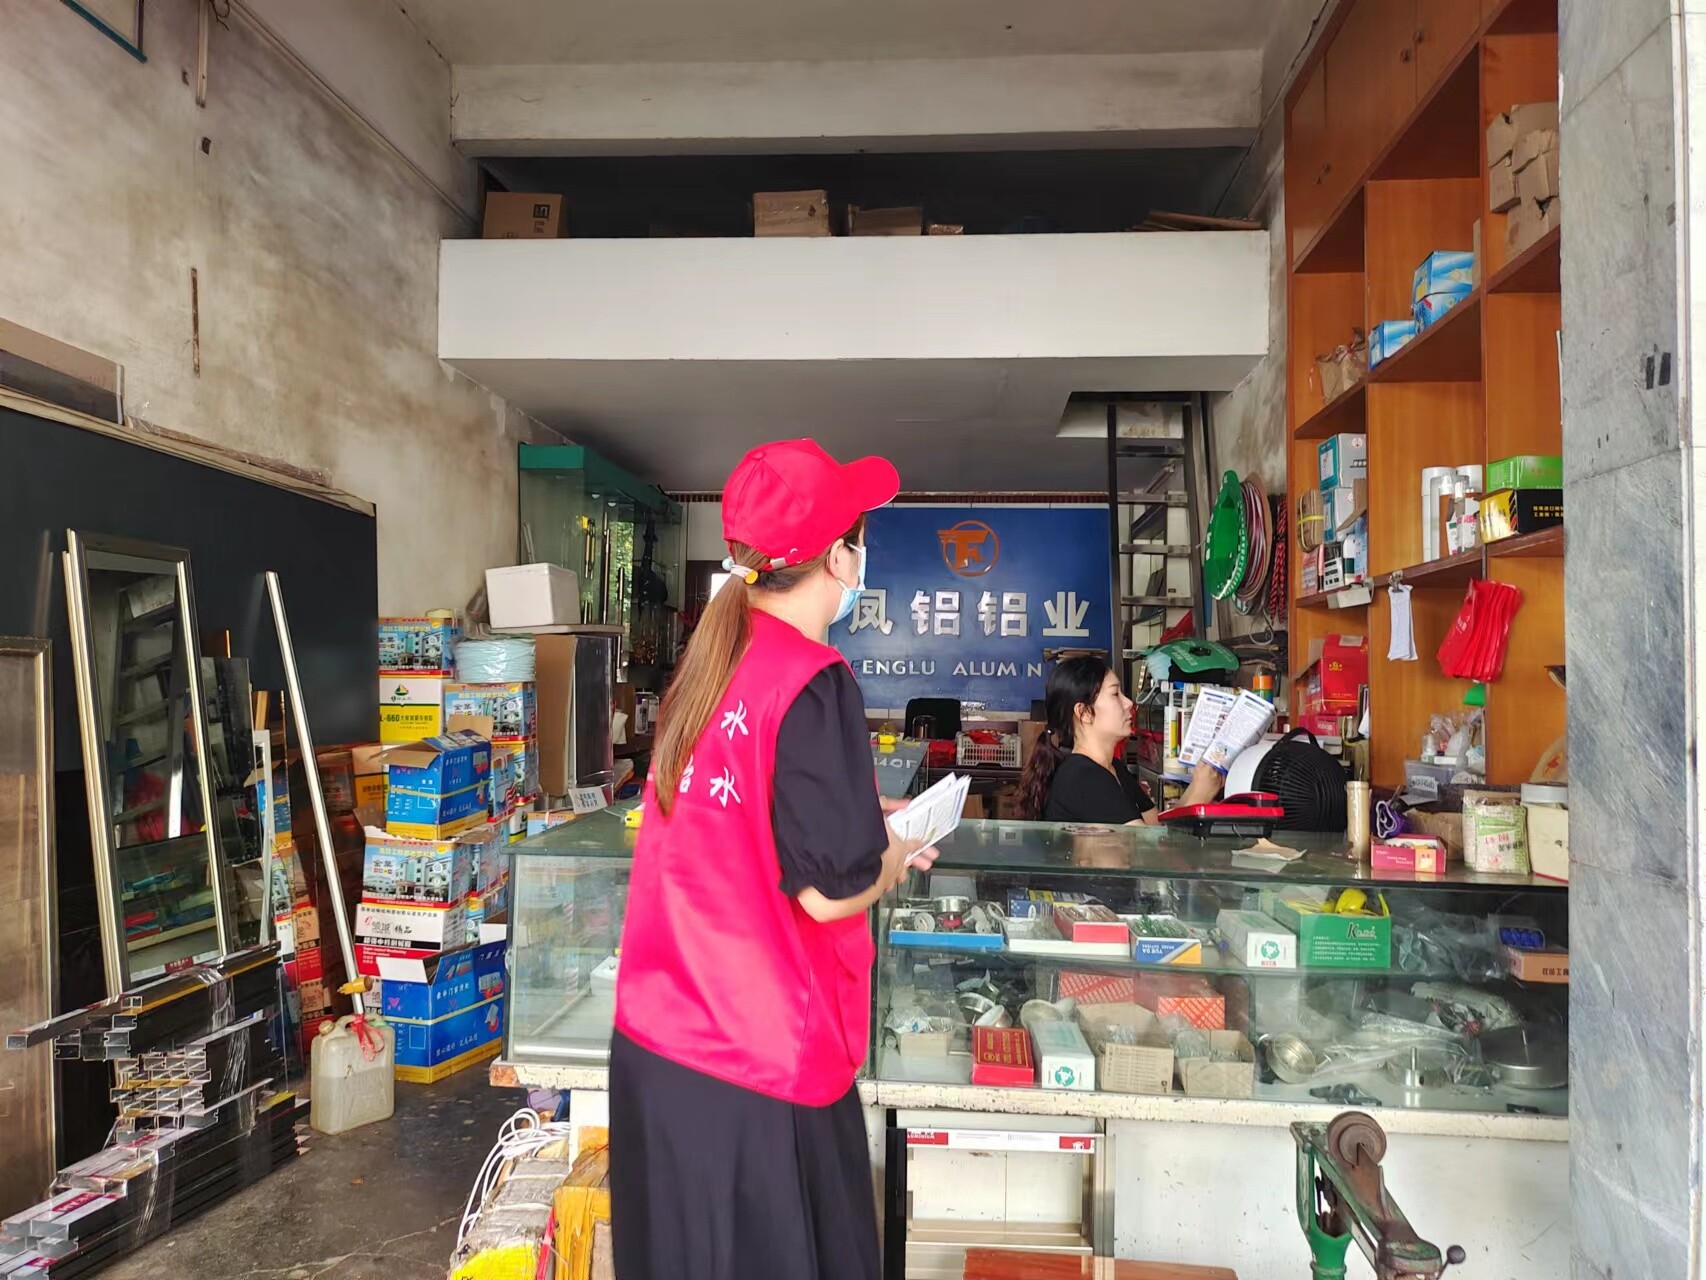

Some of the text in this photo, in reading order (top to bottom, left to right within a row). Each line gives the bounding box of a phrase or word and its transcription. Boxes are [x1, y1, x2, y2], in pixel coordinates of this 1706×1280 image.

[849, 588, 1090, 638] 凤铝铝业
[720, 699, 749, 741] 水
